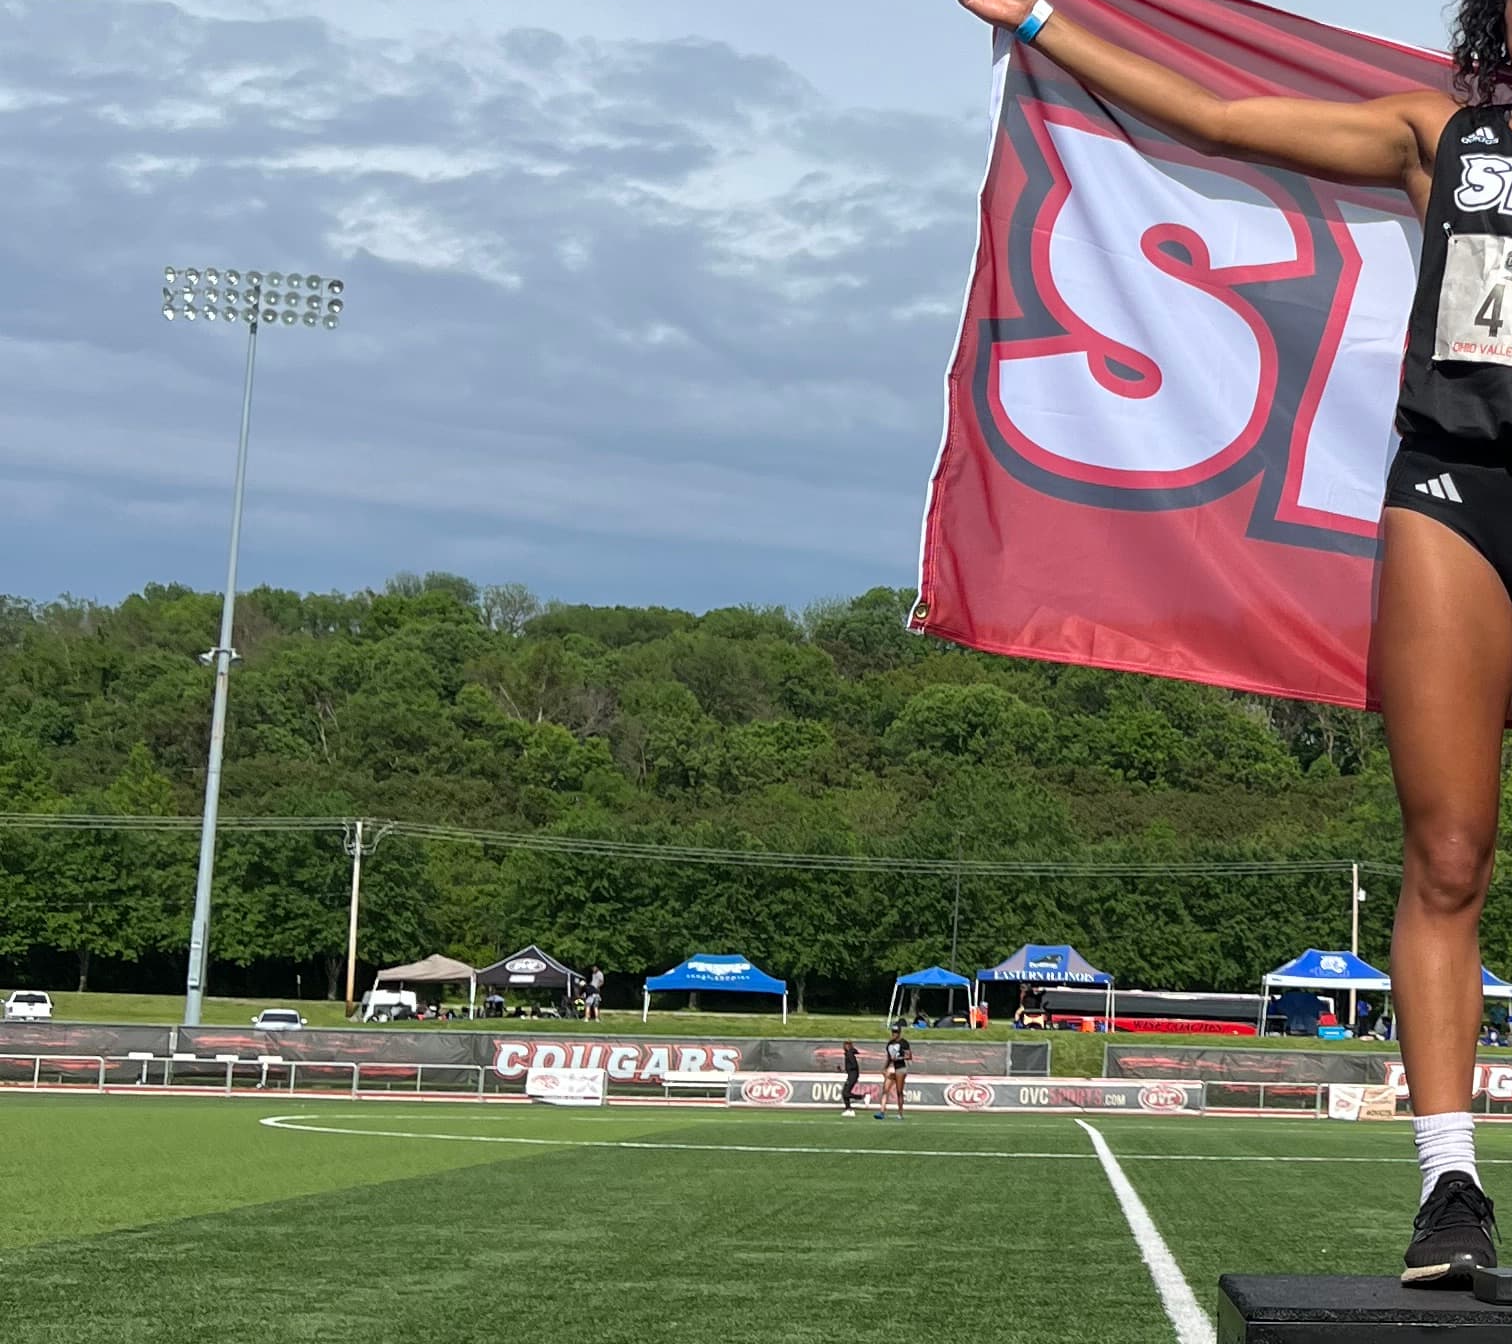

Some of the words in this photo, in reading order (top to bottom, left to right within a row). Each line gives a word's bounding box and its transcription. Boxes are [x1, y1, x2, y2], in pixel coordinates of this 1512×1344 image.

[1452, 341, 1477, 354] OHIO
[994, 970, 1044, 981] EASTERN
[1046, 971, 1096, 983] ILLINOIS
[494, 1040, 742, 1083] COUGARS
[752, 1085, 782, 1098] OVC
[954, 1090, 982, 1102] OVC
[1148, 1092, 1176, 1104] OVC
